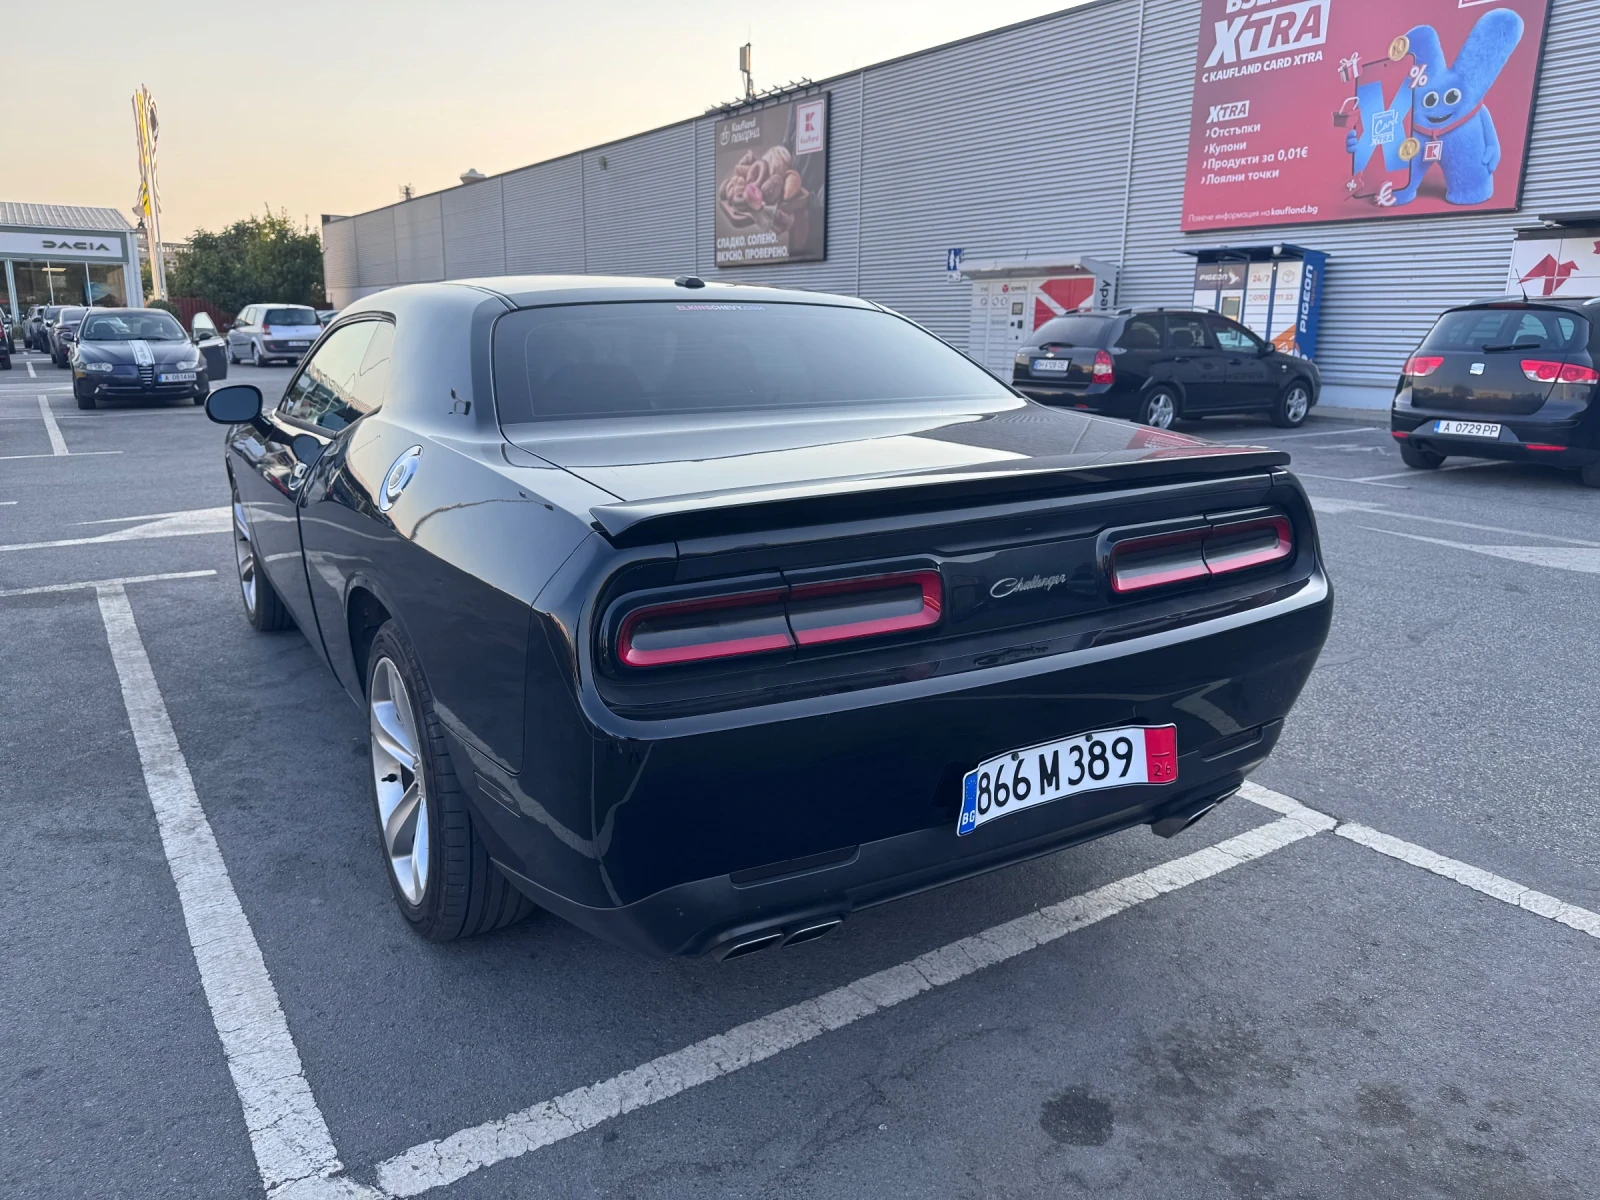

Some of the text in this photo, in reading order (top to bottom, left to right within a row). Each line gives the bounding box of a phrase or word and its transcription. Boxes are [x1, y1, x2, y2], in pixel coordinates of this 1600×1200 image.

[1204, 2, 1327, 68] XTRA
[1209, 62, 1261, 82] KAUFLAND
[1263, 57, 1292, 71] CARD
[1293, 51, 1323, 66] XTRA
[1206, 100, 1250, 123] XTRA
[1211, 123, 1261, 138] Отстъпки
[1209, 142, 1247, 156] Купони
[1208, 146, 1308, 171] Продукти за 0,01€
[1206, 169, 1279, 185] Лоялни точки
[1271, 204, 1318, 217] kaufland.bg
[42, 240, 110, 251] DACIA
[745, 246, 789, 260] ПРОВЕРЕНО.
[1252, 274, 1270, 283] 24/7
[1099, 279, 1112, 311] edy
[1300, 264, 1314, 333] PIGEON
[1444, 422, 1450, 432] A
[990, 574, 1066, 598] Challenger
[977, 737, 1133, 815] 866 M 389
[962, 808, 976, 826] BG
